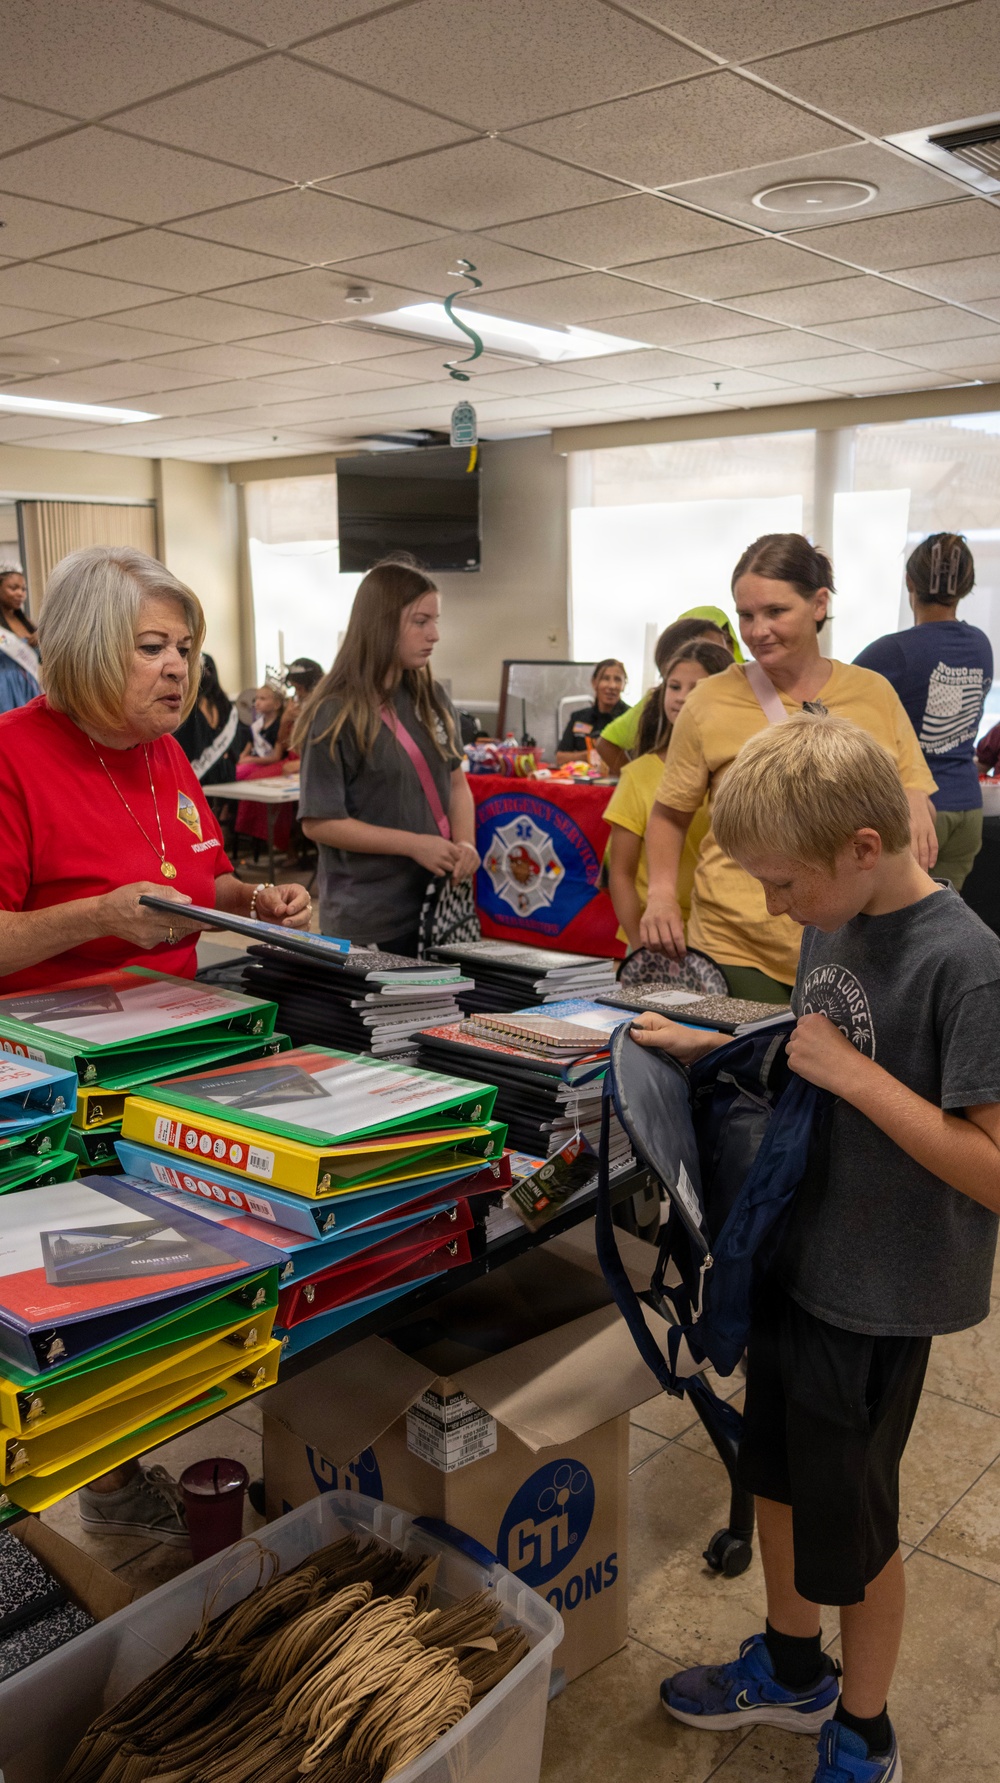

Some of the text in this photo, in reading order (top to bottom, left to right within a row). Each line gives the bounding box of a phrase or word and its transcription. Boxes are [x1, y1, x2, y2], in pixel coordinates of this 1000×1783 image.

[478, 798, 600, 885] EMERGENCY SERVICES
[804, 967, 838, 996] HANG
[837, 972, 868, 1026] LOOSE
[131, 1253, 190, 1265] QUARTERLY
[449, 1393, 467, 1405] DOLLA
[508, 1512, 569, 1573] CTI
[546, 1552, 619, 1613] OONS
